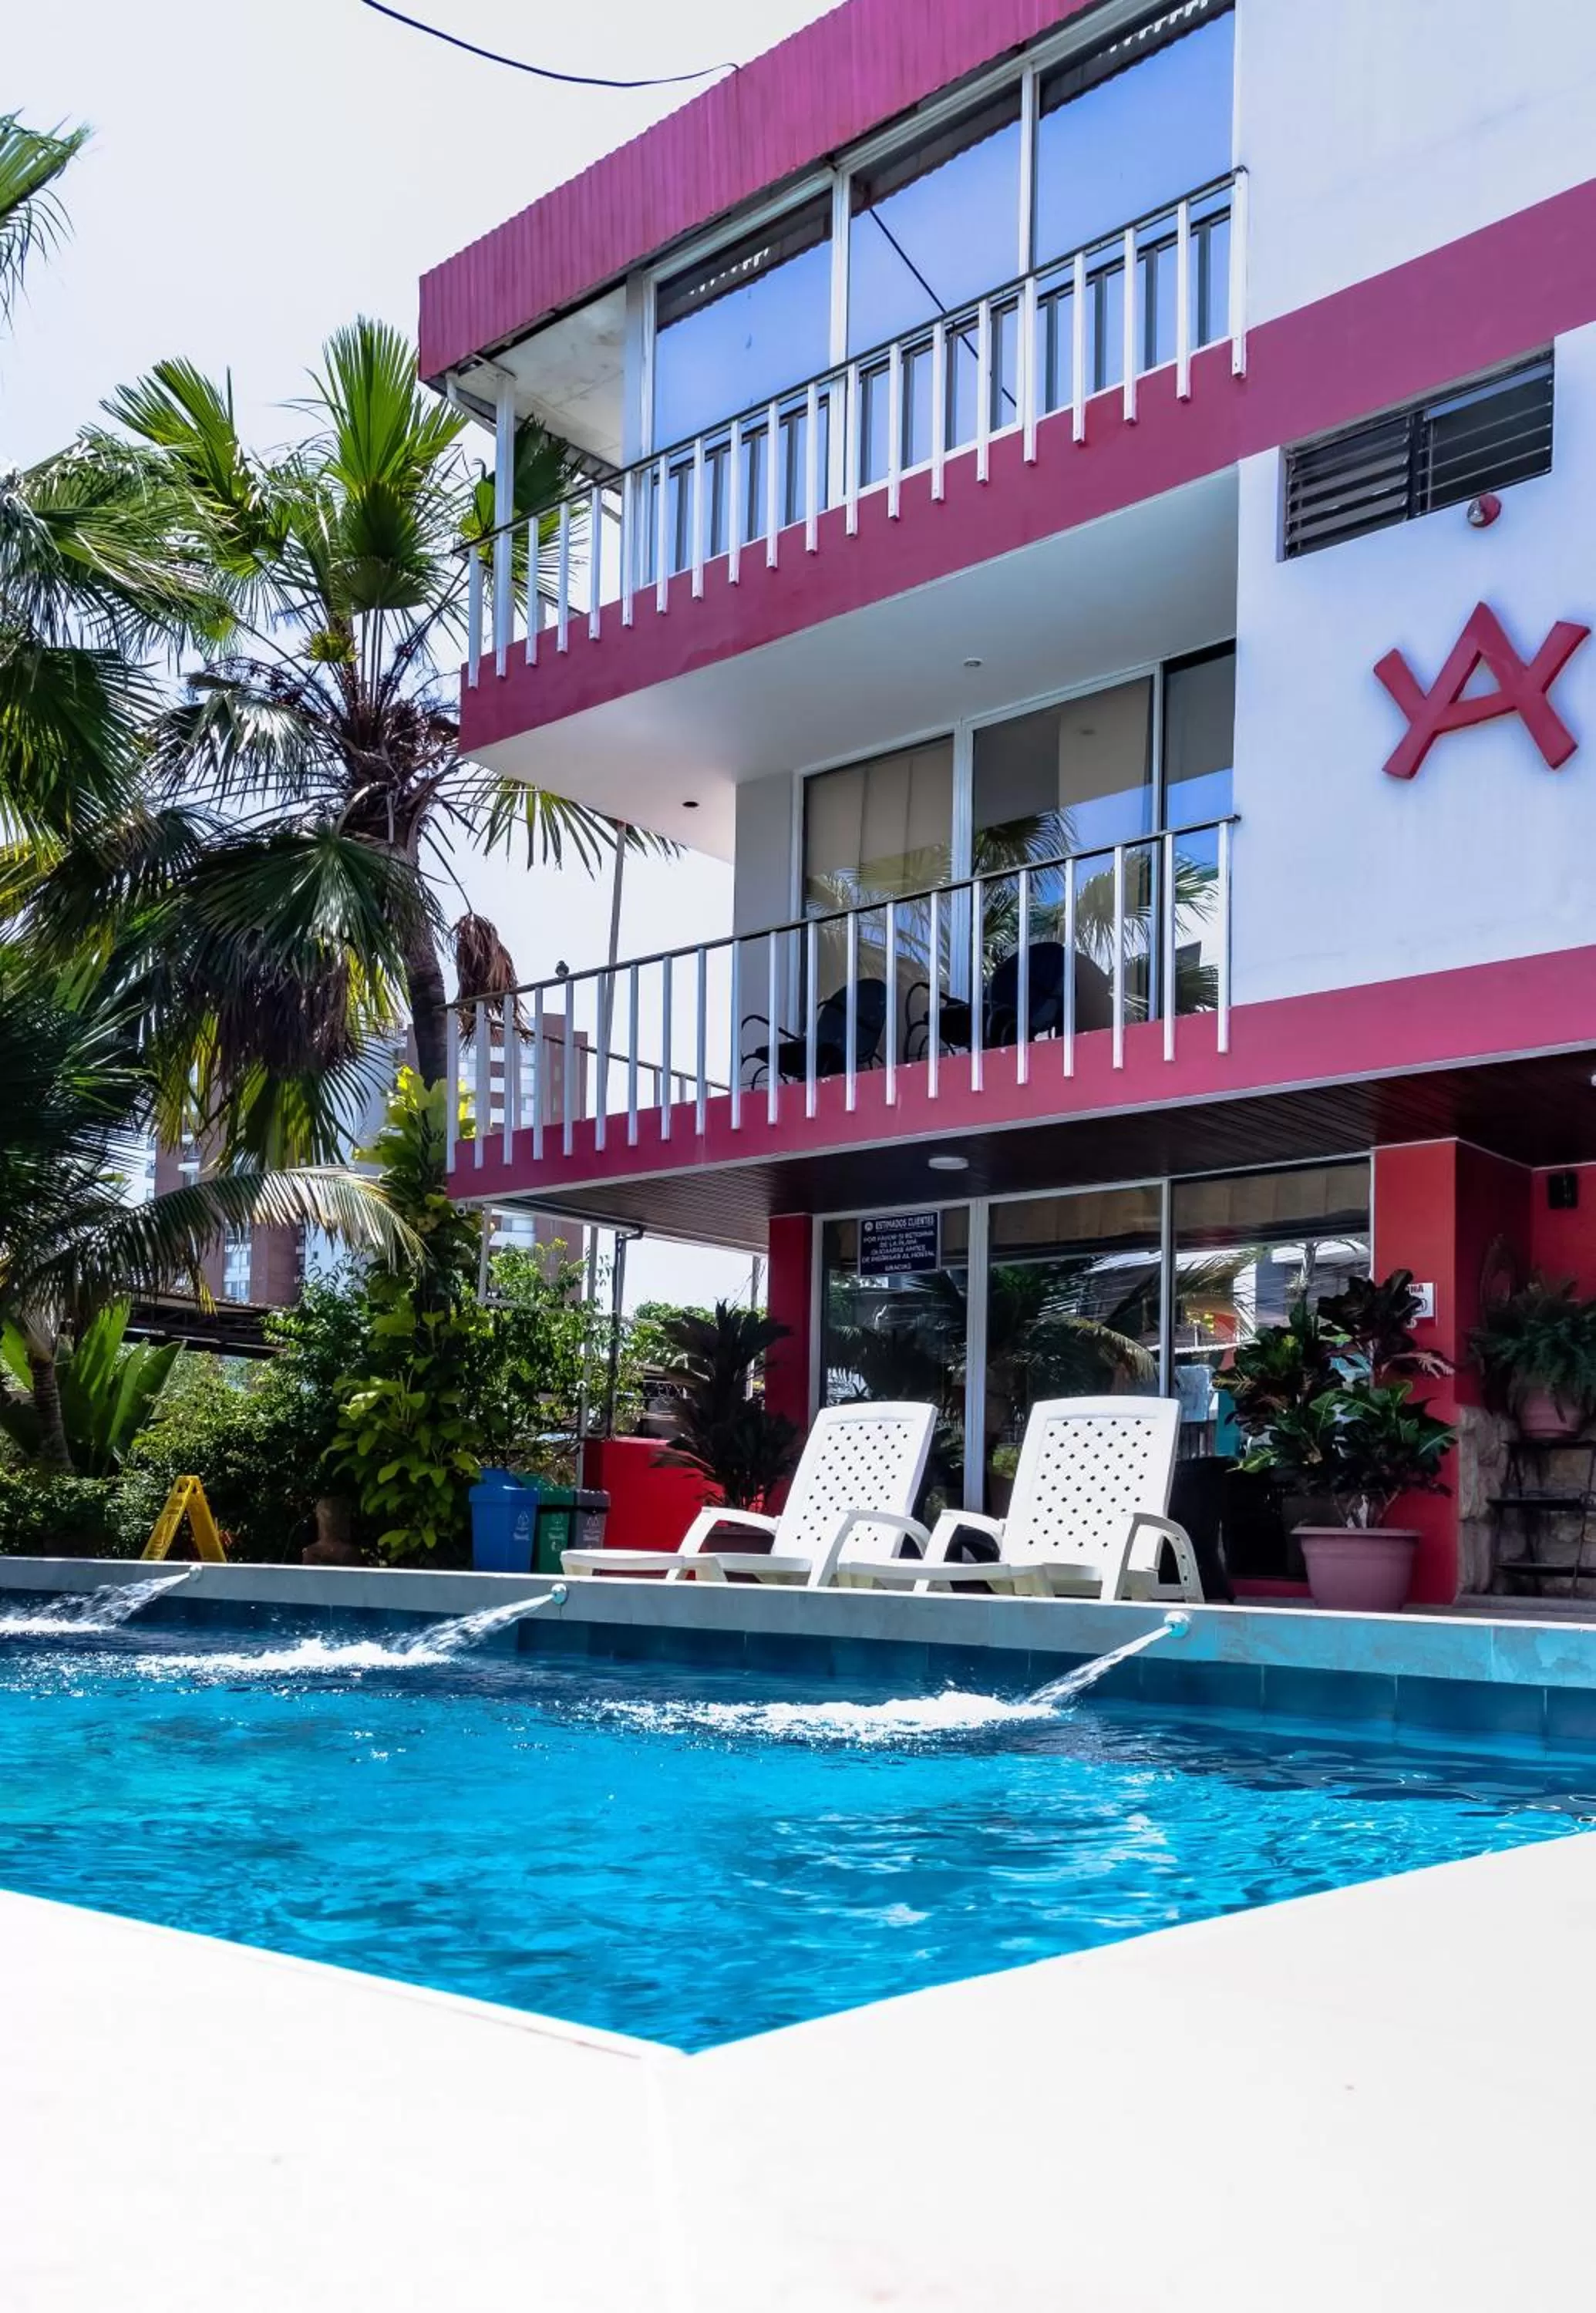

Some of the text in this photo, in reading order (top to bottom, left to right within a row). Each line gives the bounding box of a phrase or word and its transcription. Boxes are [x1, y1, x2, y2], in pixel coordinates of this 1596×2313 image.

[875, 1214, 934, 1230] ESTIMADOS CLIENTES
[884, 1262, 911, 1271] GRACIAS
